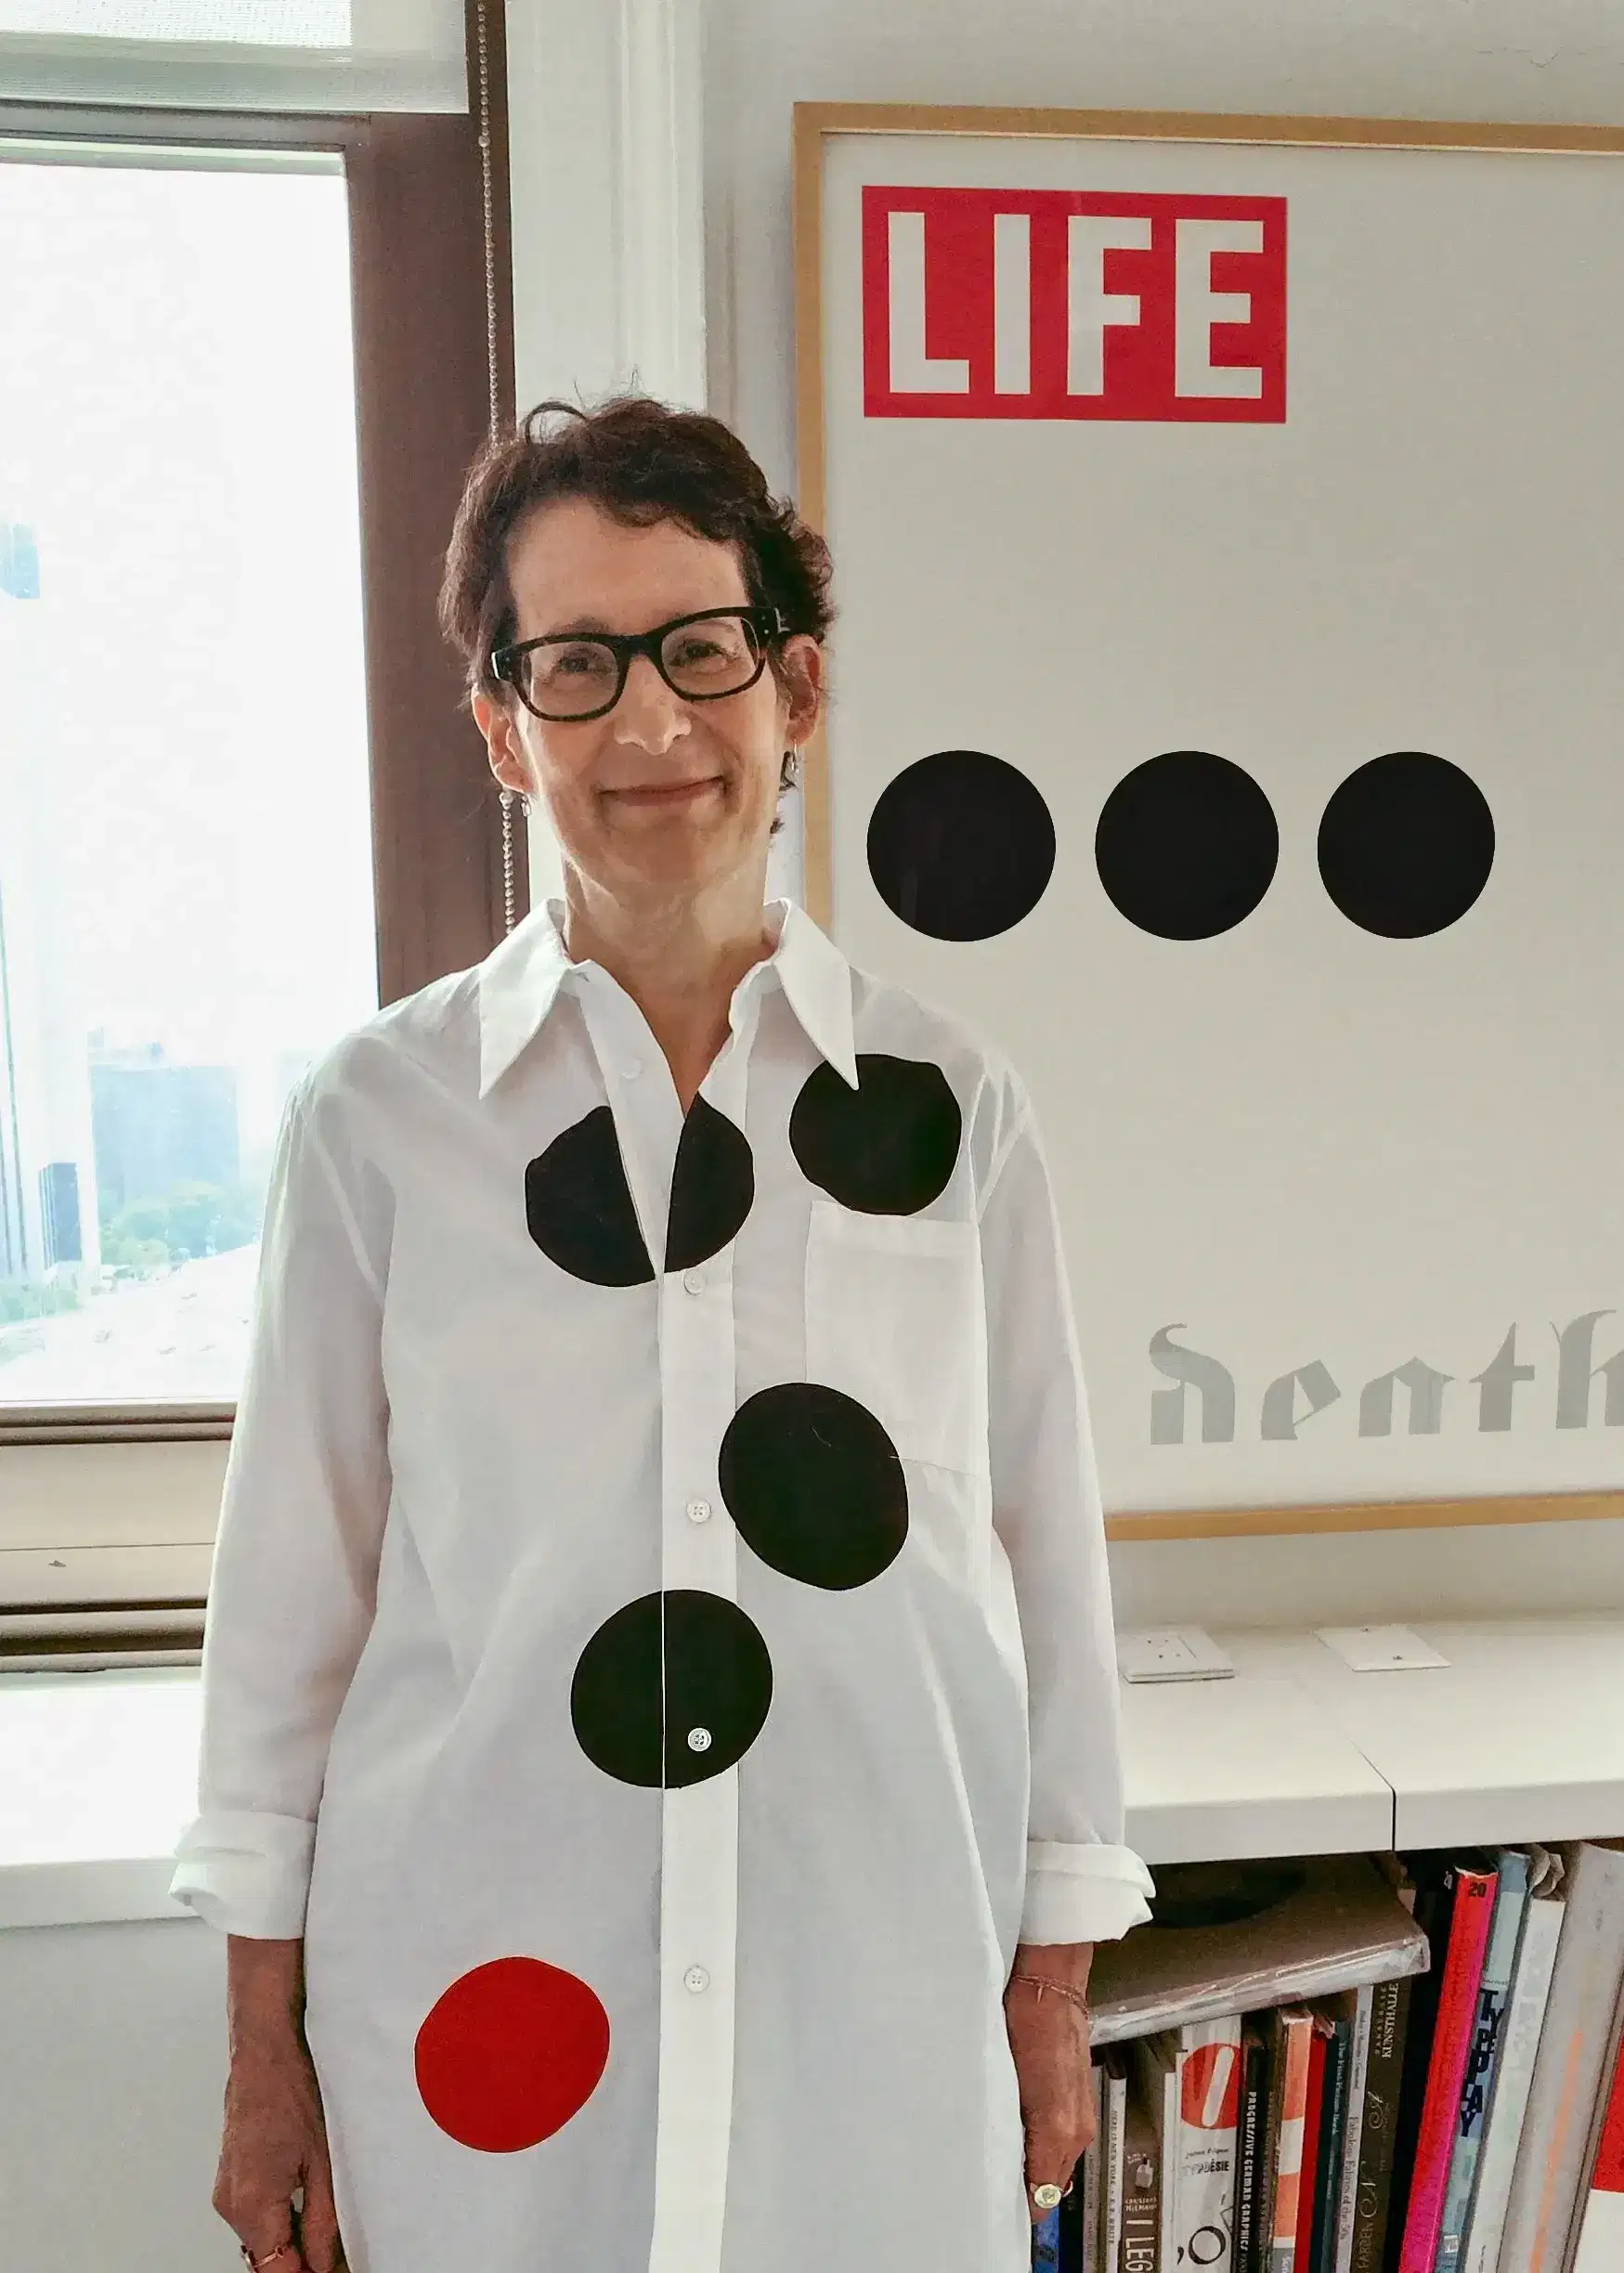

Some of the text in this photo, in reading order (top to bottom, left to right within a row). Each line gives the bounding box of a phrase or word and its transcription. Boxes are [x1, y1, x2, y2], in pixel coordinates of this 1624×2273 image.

[888, 212, 1264, 399] LIFE
[1468, 1882, 1488, 1898] 20
[1382, 1982, 1399, 2059] KUNSTHALLE
[1244, 2091, 1256, 2156] PROGRESSIVE
[1242, 2157, 1254, 2201] GERMAN
[1240, 2204, 1251, 2252] GRAPHICS
